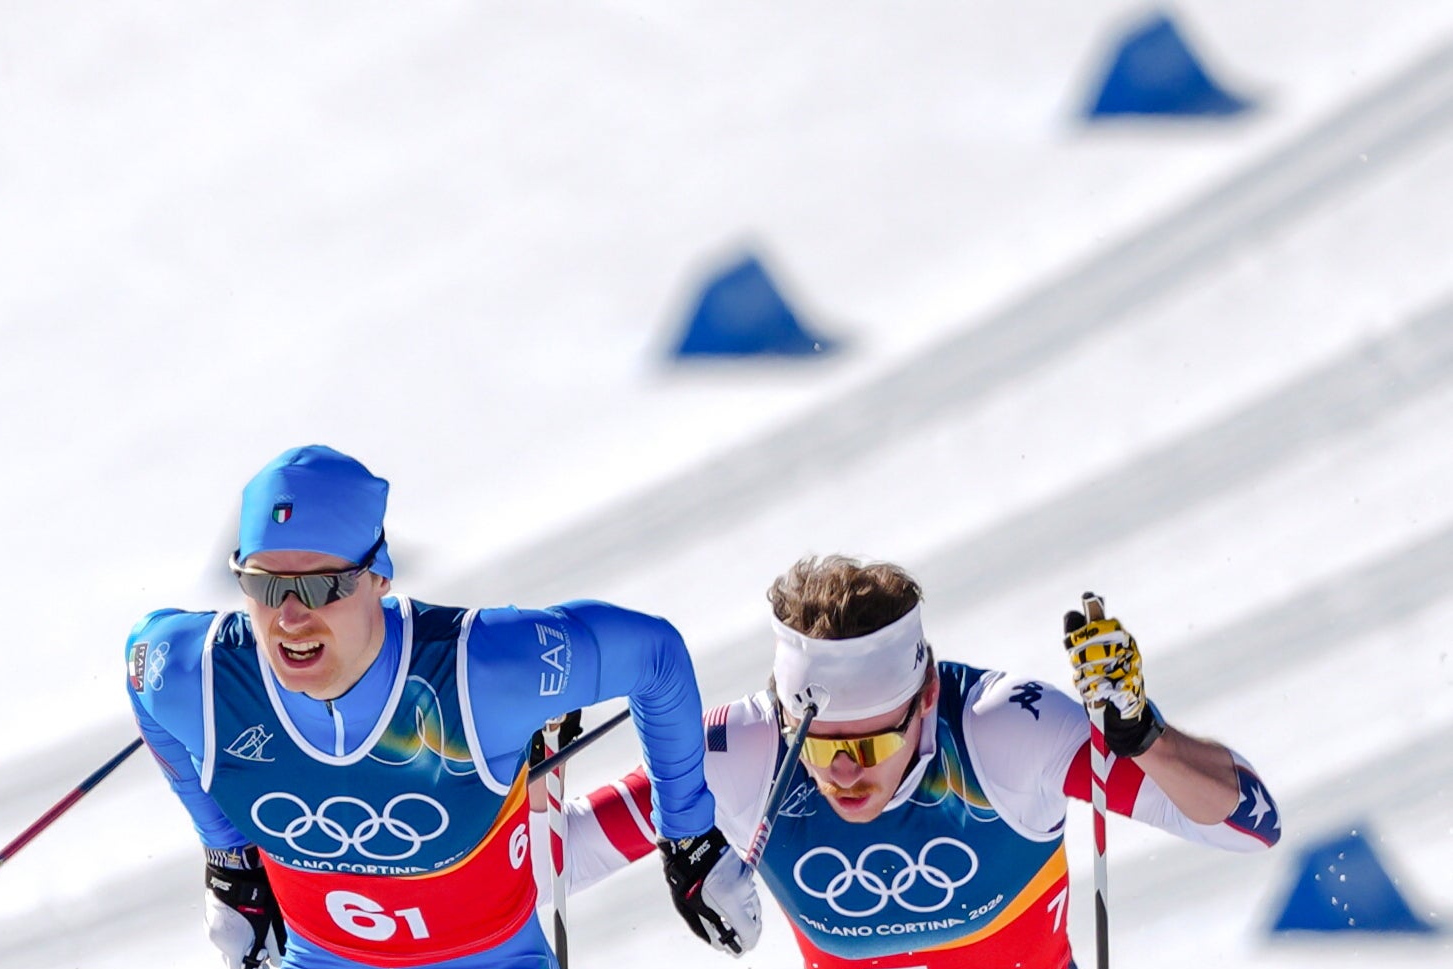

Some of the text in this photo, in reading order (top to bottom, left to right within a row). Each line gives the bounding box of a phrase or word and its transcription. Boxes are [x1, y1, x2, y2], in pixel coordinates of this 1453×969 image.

[534, 623, 565, 696] EA7
[508, 823, 529, 870] 6
[799, 893, 1005, 937] MILANO CORTINA 2026
[1047, 886, 1068, 934] 7
